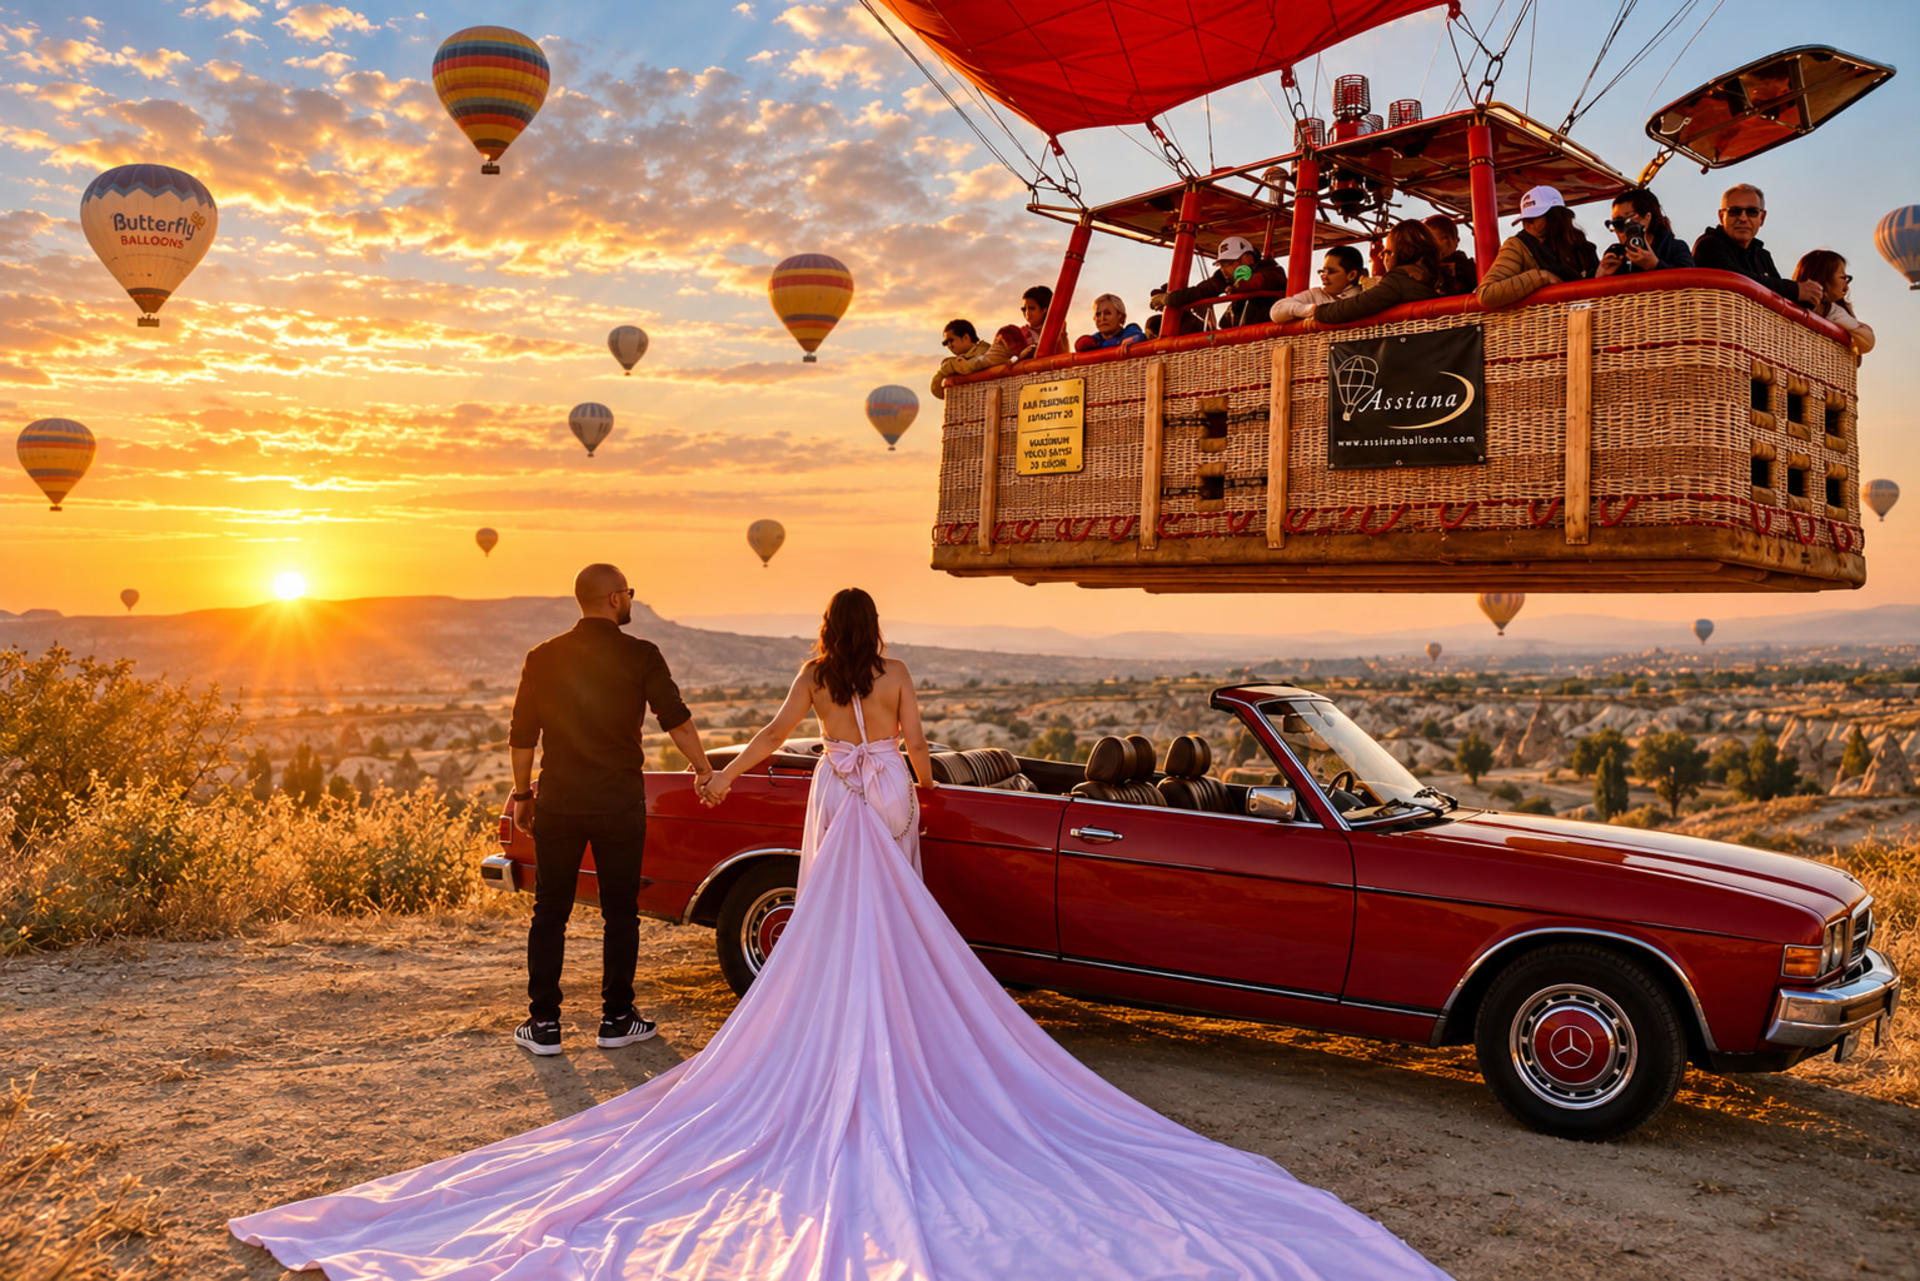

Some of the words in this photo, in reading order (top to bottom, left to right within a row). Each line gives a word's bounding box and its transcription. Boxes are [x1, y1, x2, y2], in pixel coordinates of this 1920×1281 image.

[113, 213, 195, 240] Butterfly
[120, 235, 184, 249] BALLOONS
[1358, 388, 1458, 413] Assiana
[1337, 435, 1476, 447] www.assianaballoons.com
